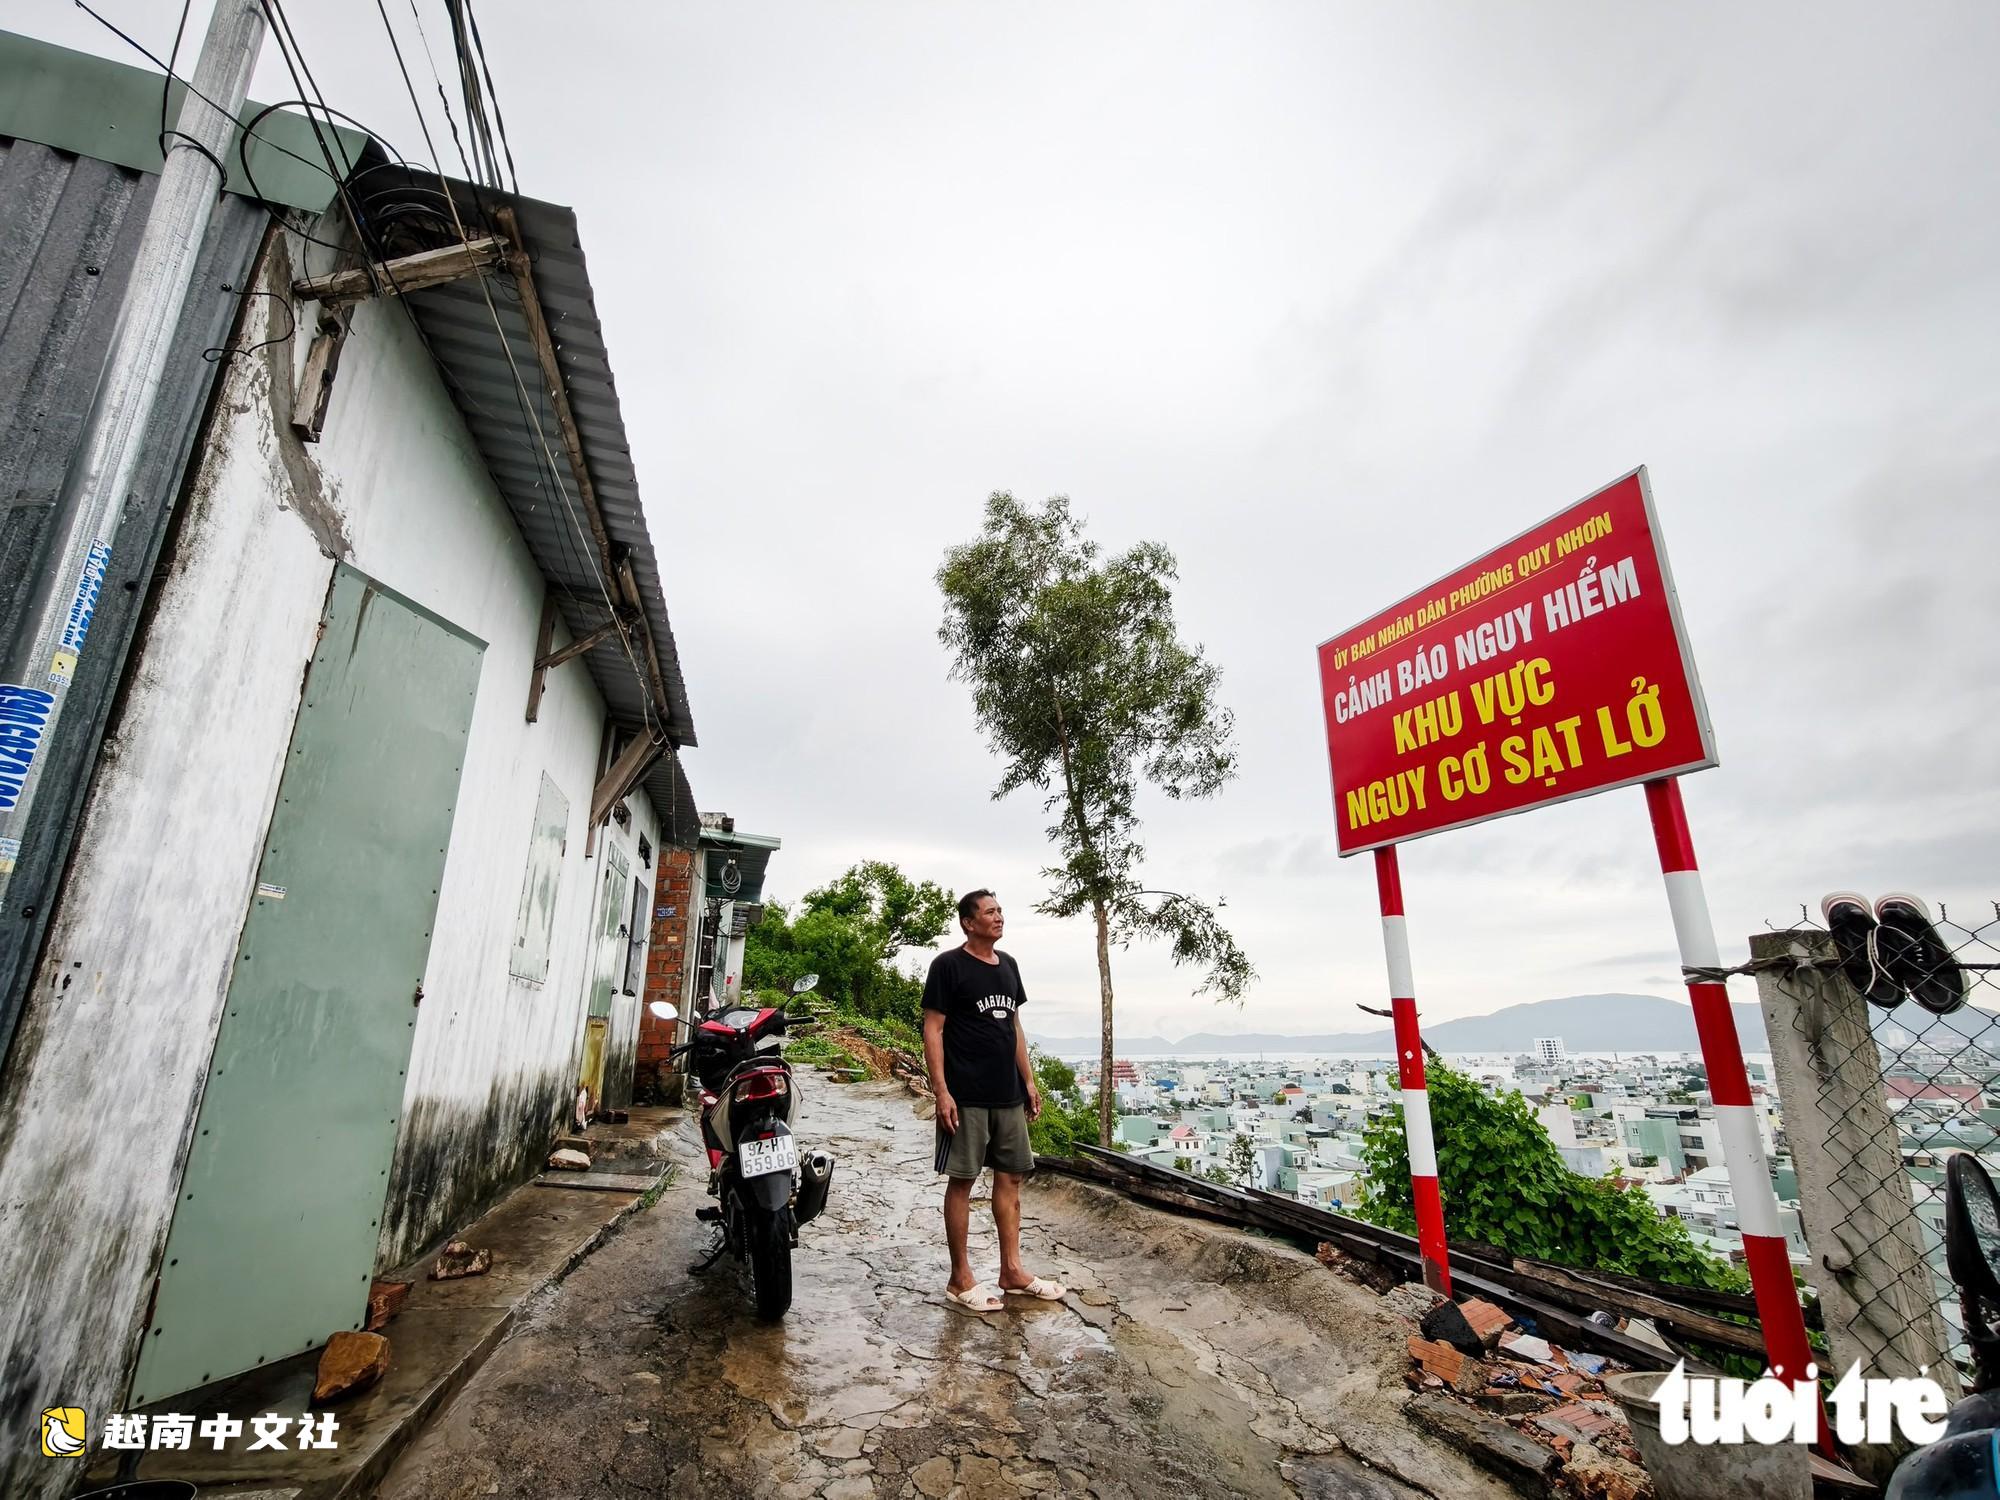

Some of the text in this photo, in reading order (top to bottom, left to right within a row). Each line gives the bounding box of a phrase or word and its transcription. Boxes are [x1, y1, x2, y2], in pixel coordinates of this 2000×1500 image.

[1334, 511, 1613, 670] ỦY BAN NHÂN DÂN PHƯỜNG QUY NHƠN
[1335, 556, 1641, 724] CẢNH BÁO NGUY HIỂM
[1346, 676, 1666, 829] NGUY CƠ SẠT LỞ
[1392, 658, 1556, 755] KHU VỰC
[745, 1152, 795, 1174] 559.86
[748, 1137, 786, 1157] 92-H1
